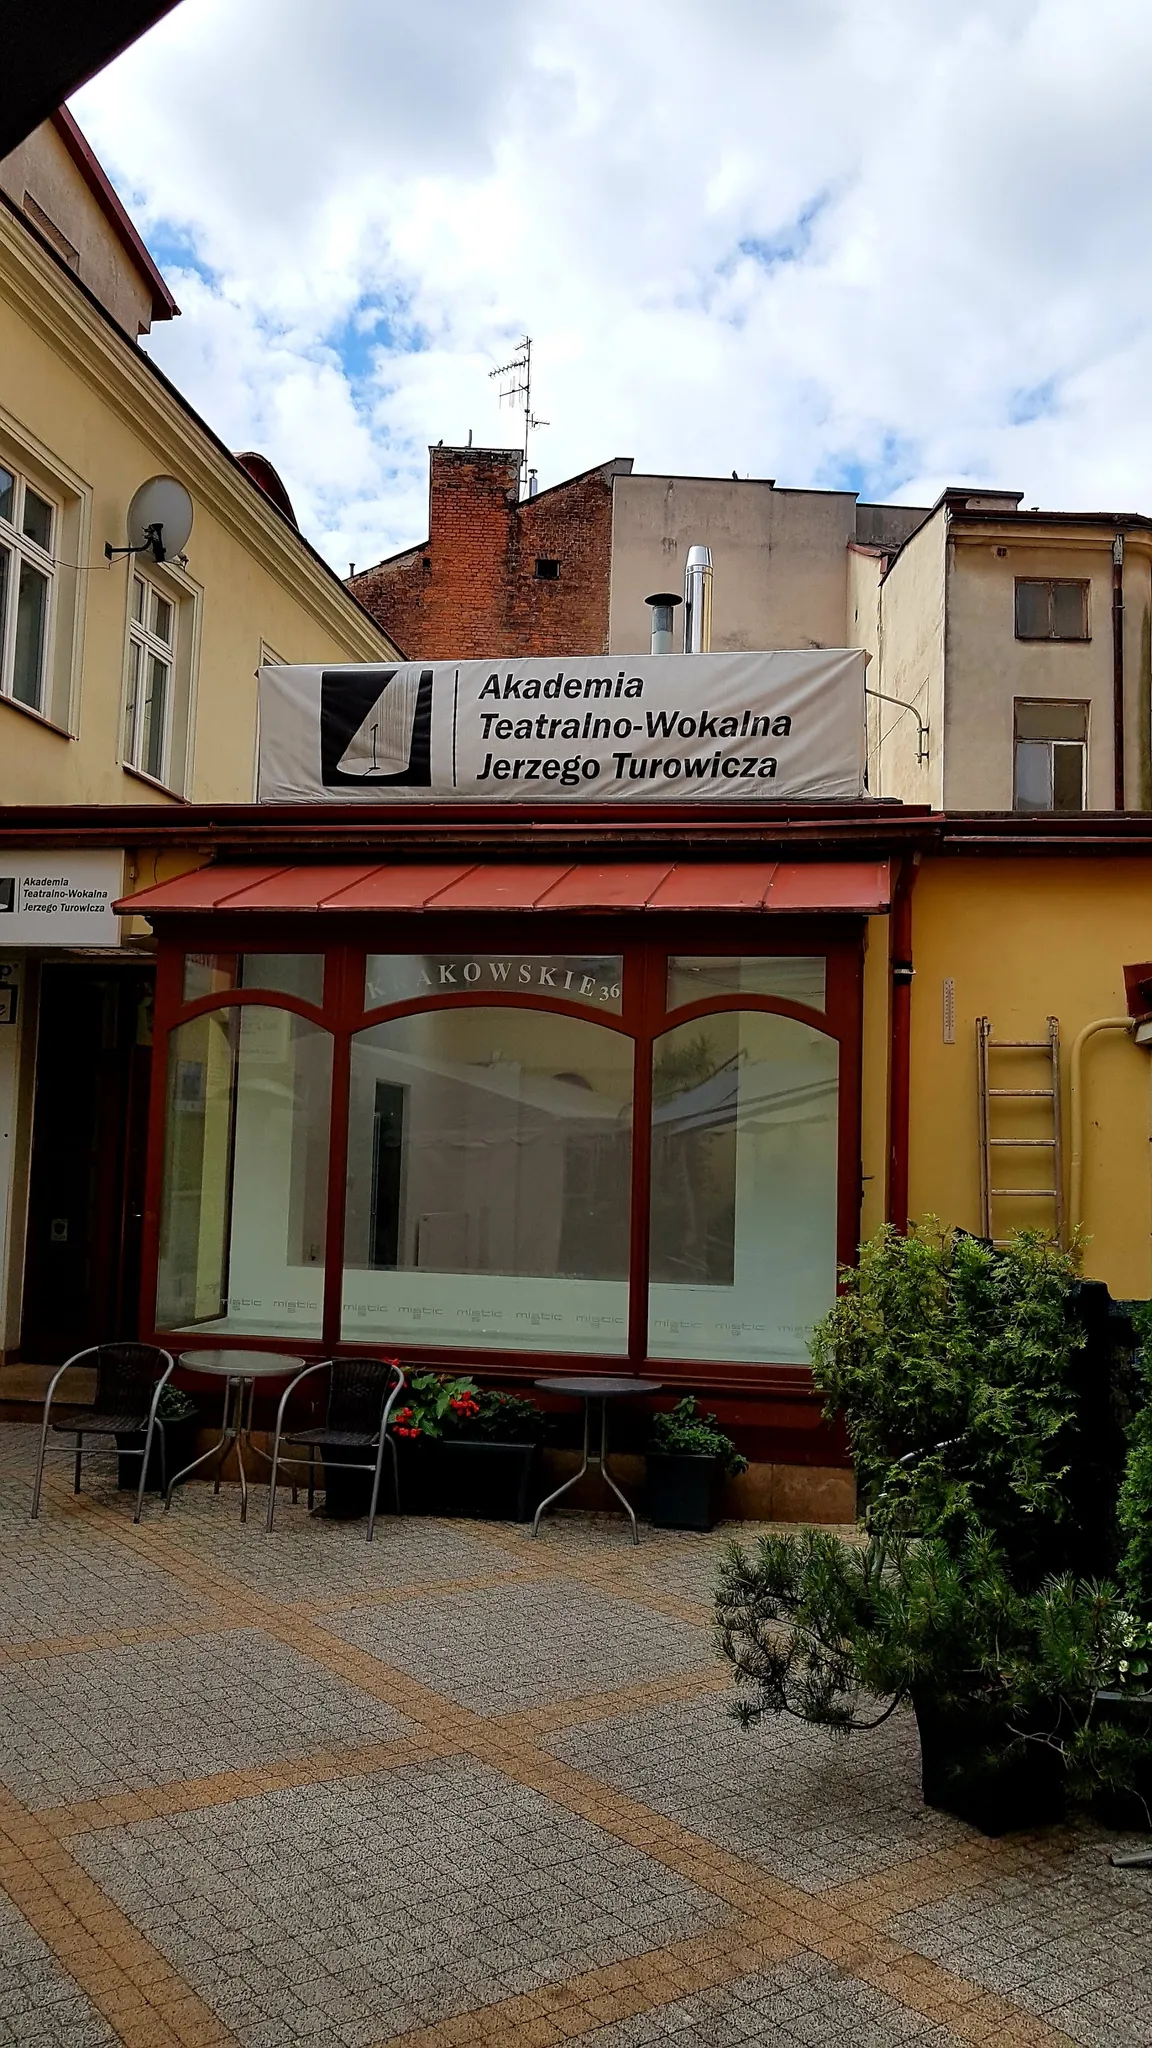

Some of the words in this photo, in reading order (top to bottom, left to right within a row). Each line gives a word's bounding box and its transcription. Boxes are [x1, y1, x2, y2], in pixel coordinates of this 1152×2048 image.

[478, 671, 645, 700] Akademia
[479, 710, 793, 740] Teatralno-Wokalna
[477, 752, 601, 787] Jerzego
[612, 751, 779, 780] Turowicza
[23, 877, 69, 887] Akademia
[23, 889, 108, 899] Teatralno-Wokalna
[23, 902, 58, 913] Jerzego
[60, 903, 105, 913] Turowicza
[367, 962, 597, 1000] KAKOWSKIE
[599, 983, 620, 1002] 36
[273, 1301, 318, 1313] mistic
[343, 1303, 389, 1317] mistic
[398, 1305, 443, 1319] mistic
[456, 1308, 502, 1322] mistic
[515, 1310, 563, 1325] mistic
[777, 1324, 816, 1339] mist
